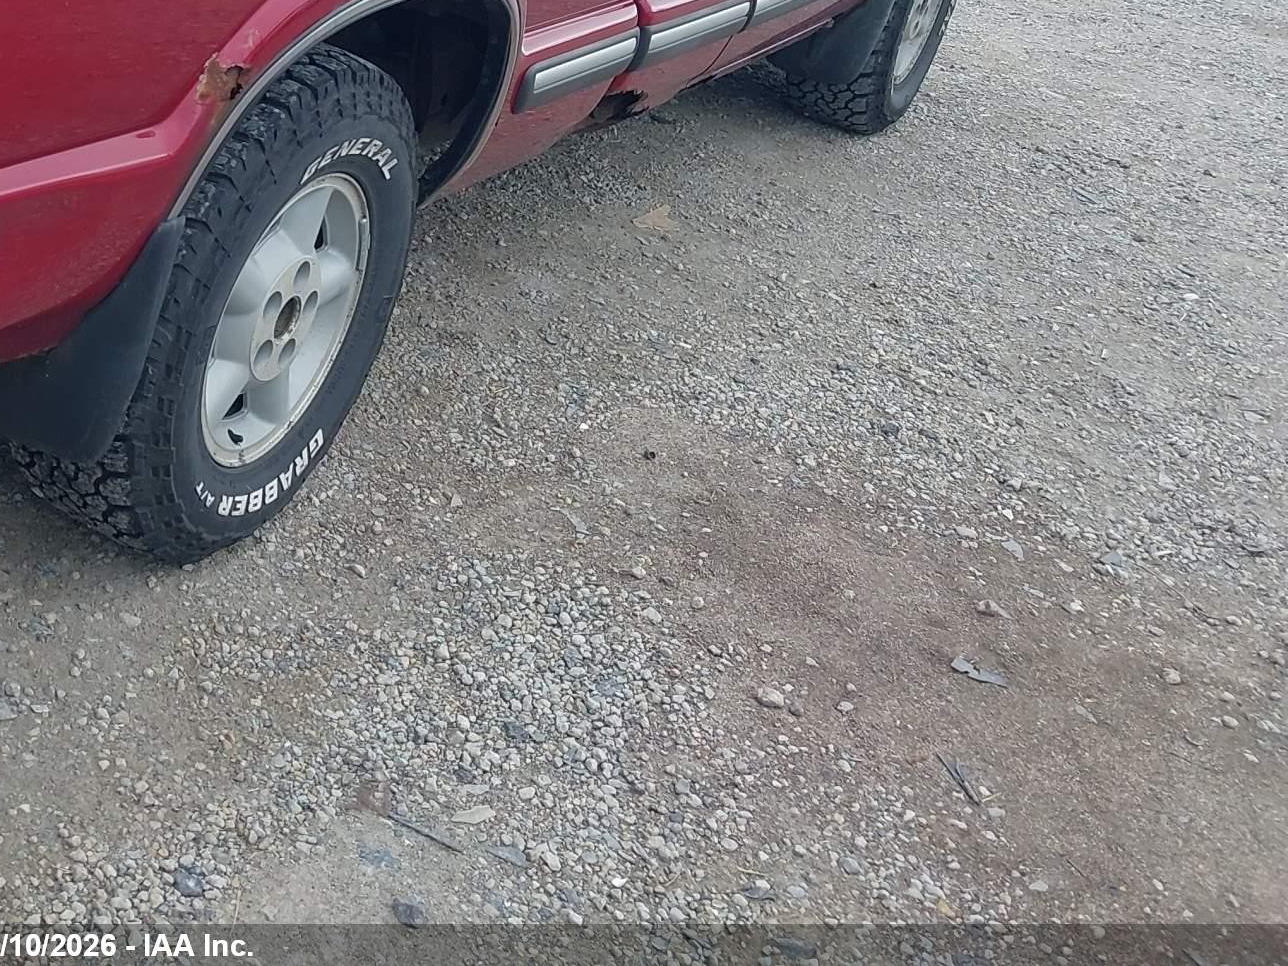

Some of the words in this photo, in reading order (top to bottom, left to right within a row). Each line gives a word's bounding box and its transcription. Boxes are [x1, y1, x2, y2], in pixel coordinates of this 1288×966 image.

[299, 137, 399, 185] GENERAL
[195, 481, 215, 508] A/T
[217, 428, 324, 516] GRABBER
